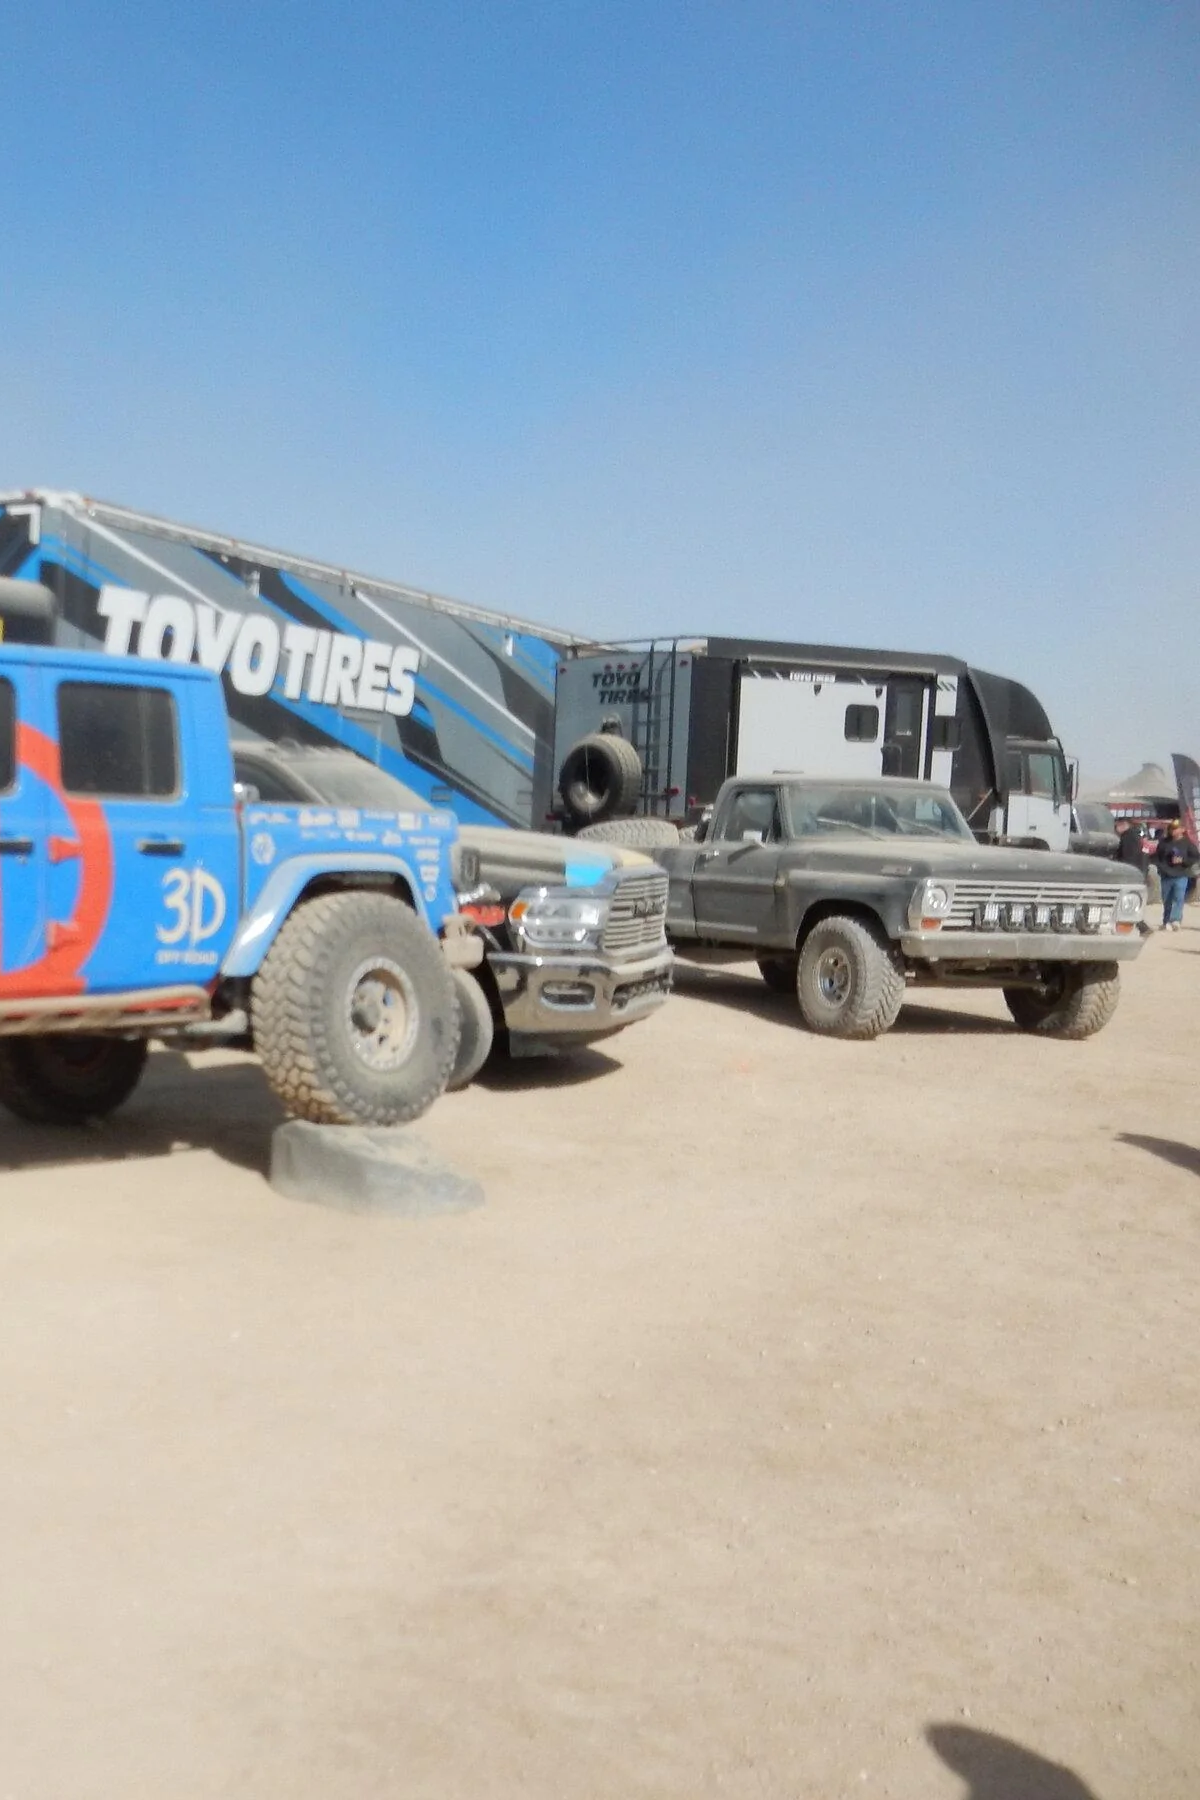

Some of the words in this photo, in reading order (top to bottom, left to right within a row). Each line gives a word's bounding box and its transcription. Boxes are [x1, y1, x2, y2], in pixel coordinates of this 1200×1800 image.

[97, 584, 281, 697] TOYO
[281, 622, 421, 717] TIRES
[593, 671, 641, 688] TOYO
[156, 866, 226, 947] 3D
